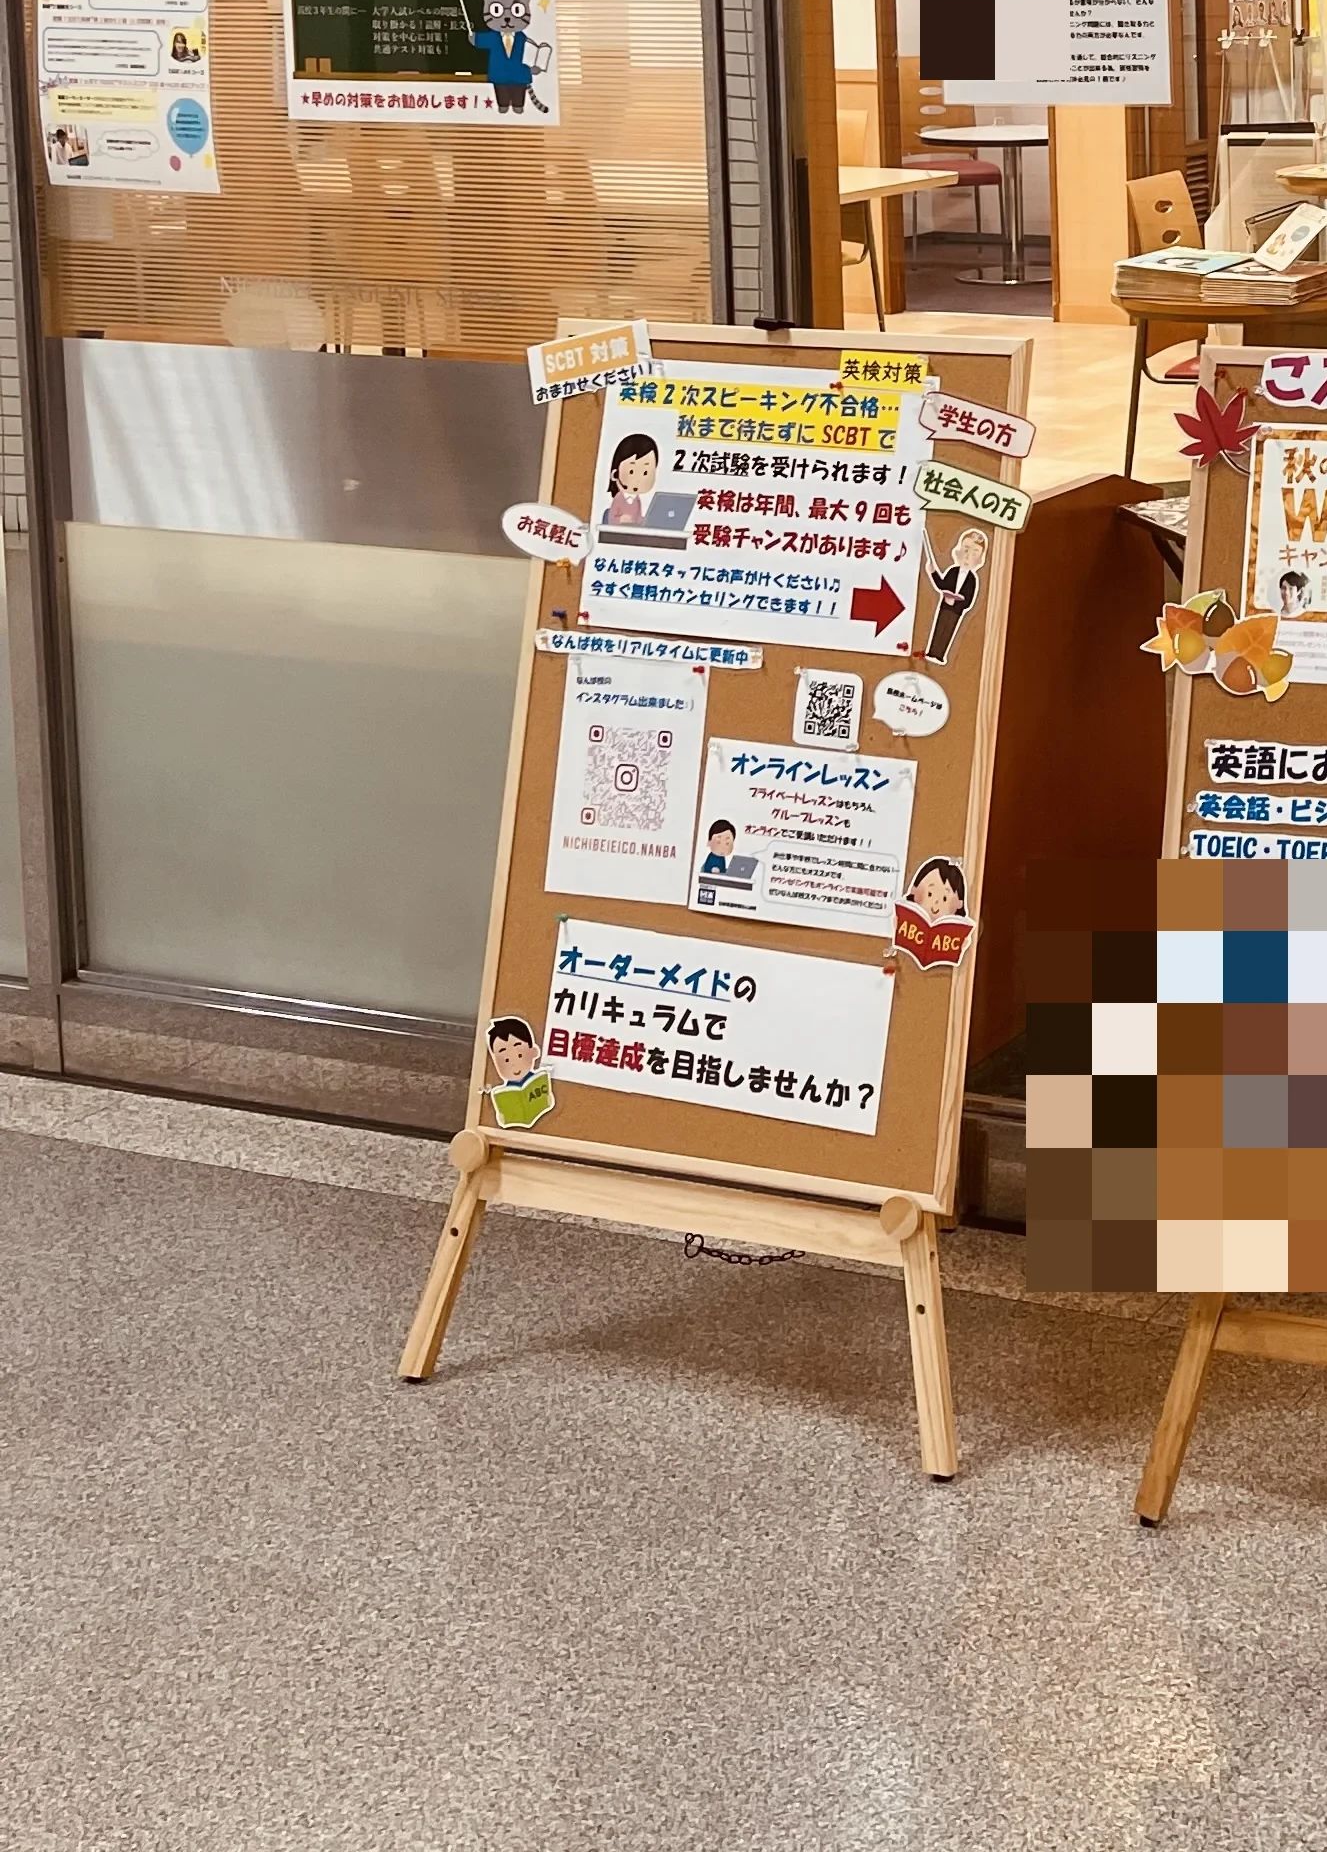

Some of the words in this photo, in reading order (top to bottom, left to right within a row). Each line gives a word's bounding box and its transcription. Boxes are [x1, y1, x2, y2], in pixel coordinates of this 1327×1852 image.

[842, 359, 923, 384] 英検対策
[938, 403, 1017, 447] 学生の方
[923, 469, 1022, 522] 社会人の方
[517, 515, 582, 548] お気軽に
[731, 752, 890, 791] オンラインレッスン
[898, 921, 925, 945] ABC
[932, 934, 960, 952] ABC
[558, 945, 757, 1003] オーダーメイドの
[553, 987, 727, 1041] カリキュラムで
[547, 1027, 875, 1110] 目標達成を目指しませんか？
[529, 1084, 549, 1103] ABC
